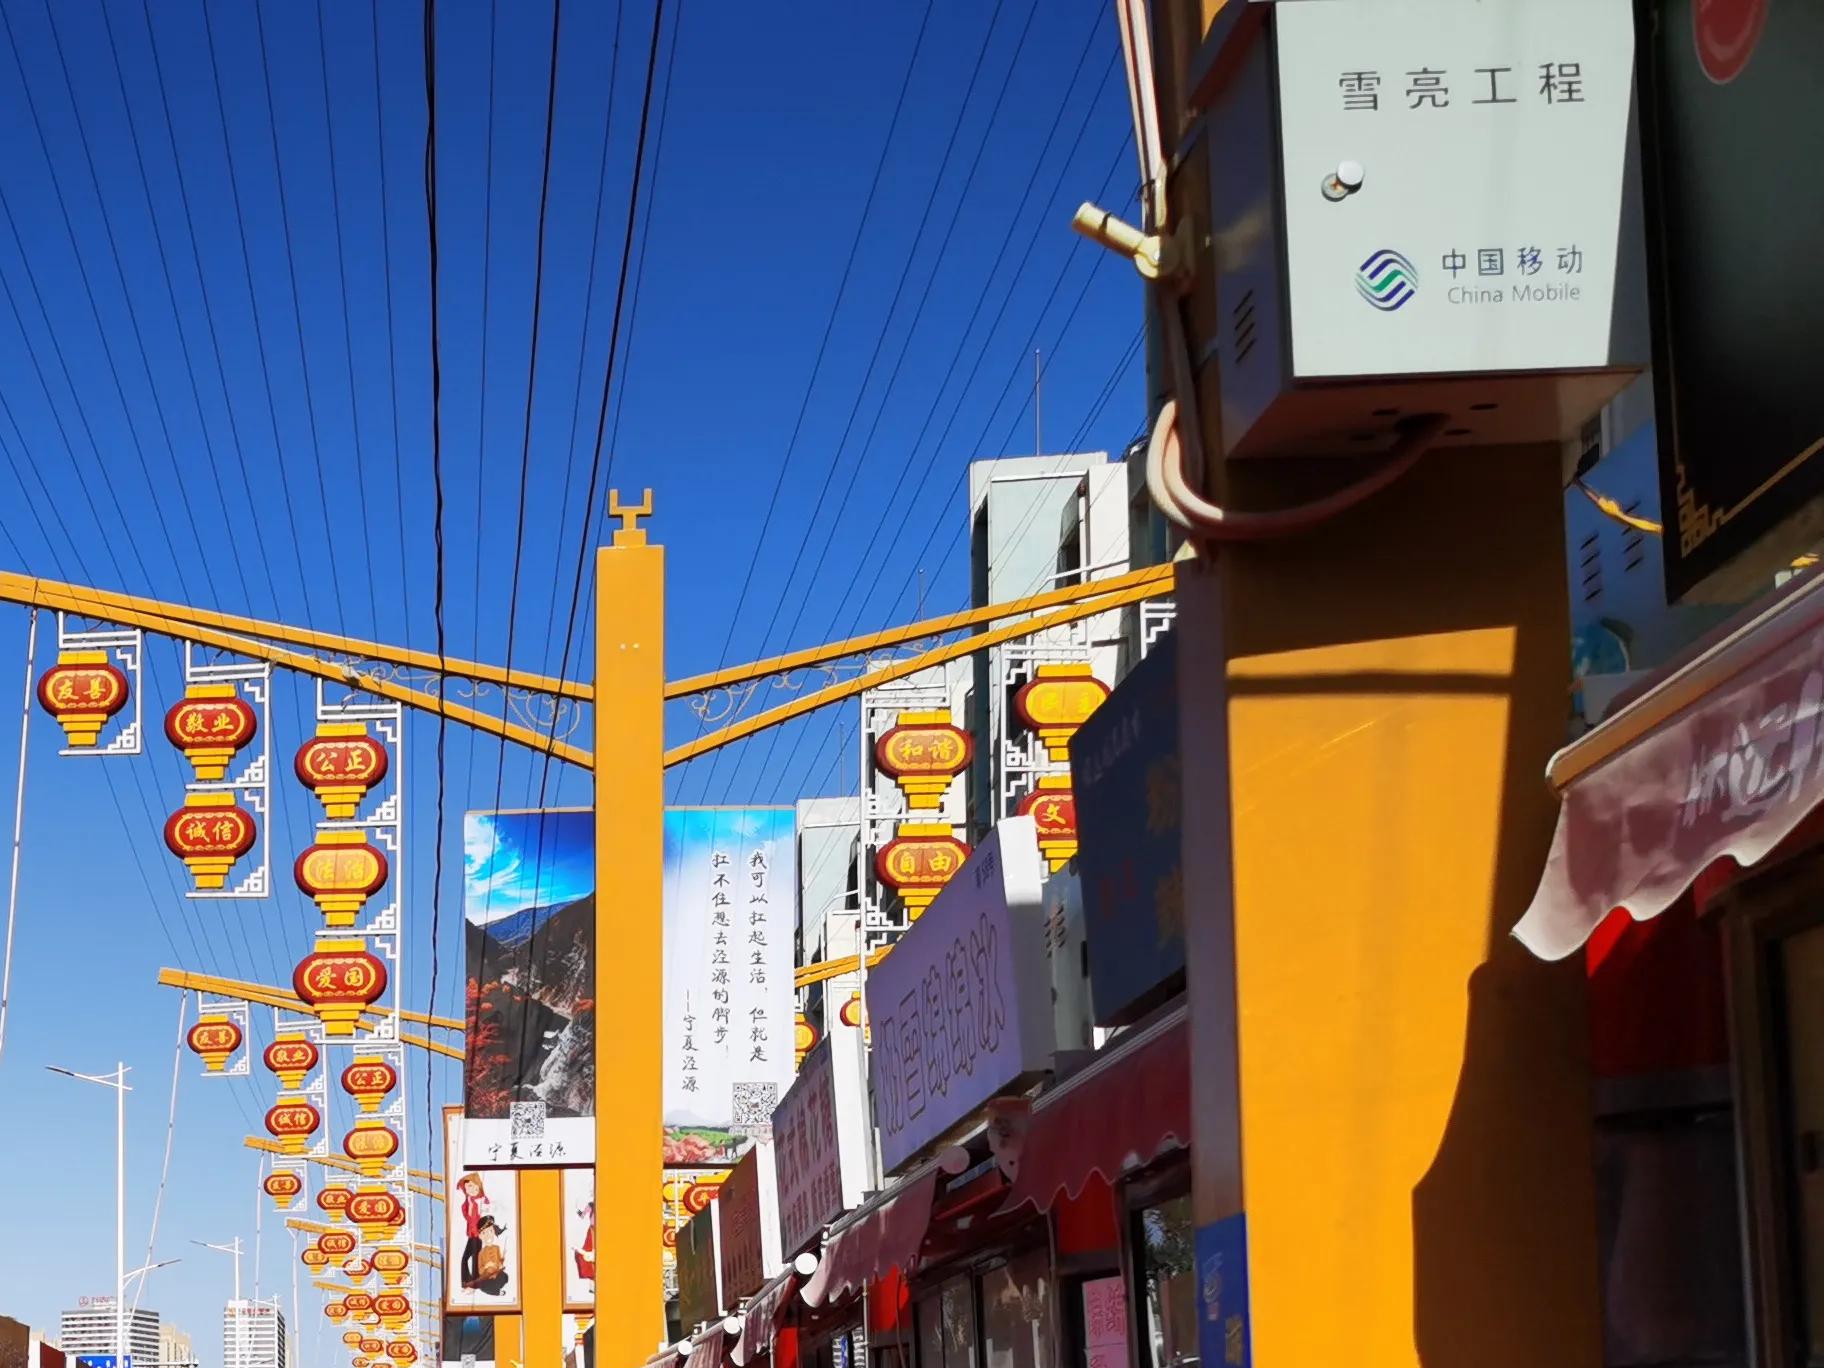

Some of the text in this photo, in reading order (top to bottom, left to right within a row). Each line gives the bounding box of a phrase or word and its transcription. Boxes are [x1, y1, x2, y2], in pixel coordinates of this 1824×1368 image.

[1338, 59, 1587, 112] 雪亮工程
[1441, 243, 1584, 278] 中国移动
[1447, 279, 1580, 305] China Mobile
[56, 680, 107, 701] 友善
[185, 713, 235, 733] 敬业
[899, 735, 956, 761] 和谐
[316, 751, 366, 773] 公正
[185, 820, 234, 841] 诚信
[315, 860, 365, 881] 法治
[900, 850, 952, 873] 自由
[315, 967, 365, 989] 爱国
[354, 1071, 385, 1085] 公正
[278, 1111, 307, 1126] 诚信
[487, 1141, 567, 1163] 宁夏泾源
